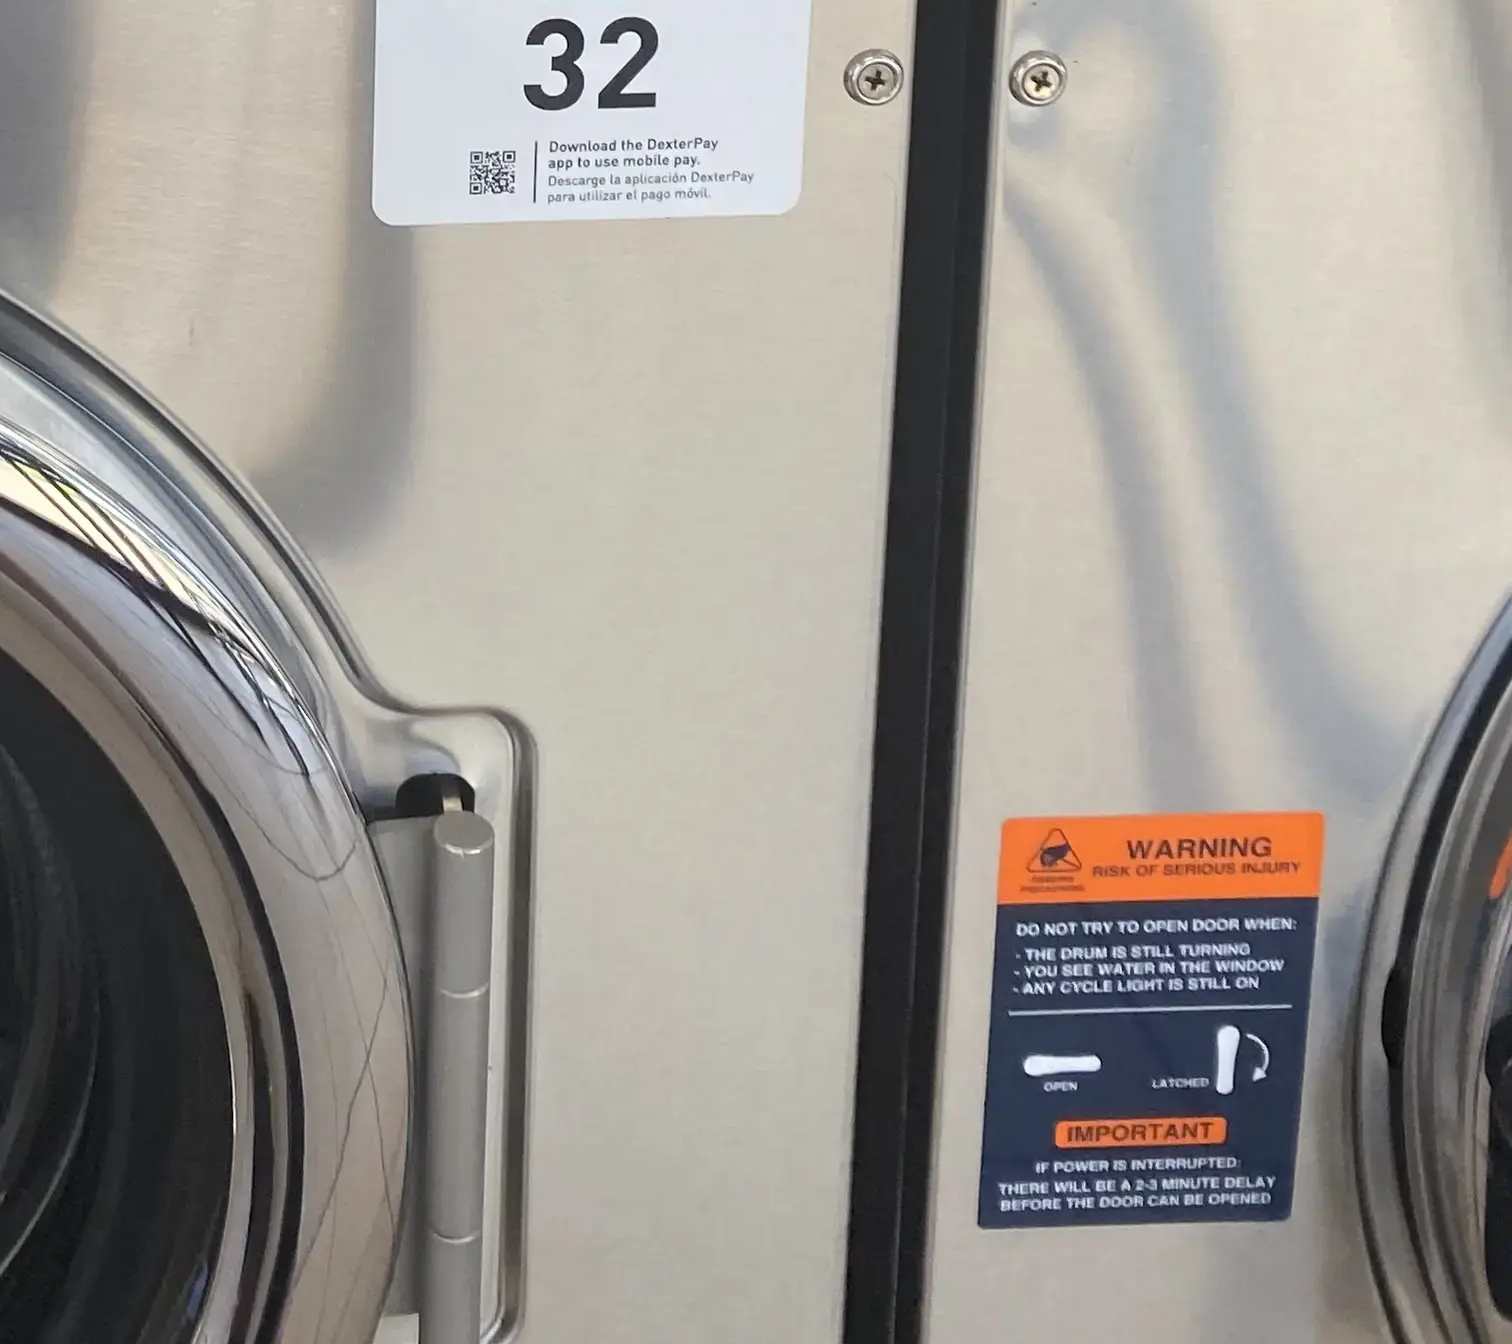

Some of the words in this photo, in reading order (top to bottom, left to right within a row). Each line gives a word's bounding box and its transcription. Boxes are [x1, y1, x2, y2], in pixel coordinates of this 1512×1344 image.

[523, 17, 659, 111] 32
[549, 140, 617, 152] Download
[621, 140, 643, 151] the
[647, 138, 718, 151] DexterPay
[548, 158, 573, 171] app
[578, 157, 590, 168] to
[595, 158, 619, 168] use
[623, 155, 669, 167] mobile
[674, 156, 700, 168] pay.
[1127, 837, 1272, 859] WARNING
[1093, 865, 1130, 877] RISK
[1136, 864, 1155, 876] OF
[1163, 863, 1235, 875] SERIOUS
[1241, 861, 1301, 874] INJURY
[1016, 924, 1040, 937] DO
[1044, 922, 1078, 935] NOT
[1082, 922, 1113, 935] TRY
[1117, 921, 1139, 934] TO
[1143, 920, 1188, 933] OPEN
[1192, 919, 1239, 932] DOOR
[1044, 1081, 1078, 1092] OPEN
[1152, 1077, 1209, 1089] LATCHED
[1067, 1122, 1215, 1143] IMPORTANT
[1036, 1162, 1049, 1174] IF
[1054, 1160, 1109, 1173] POWER
[1113, 1160, 1127, 1171] IS
